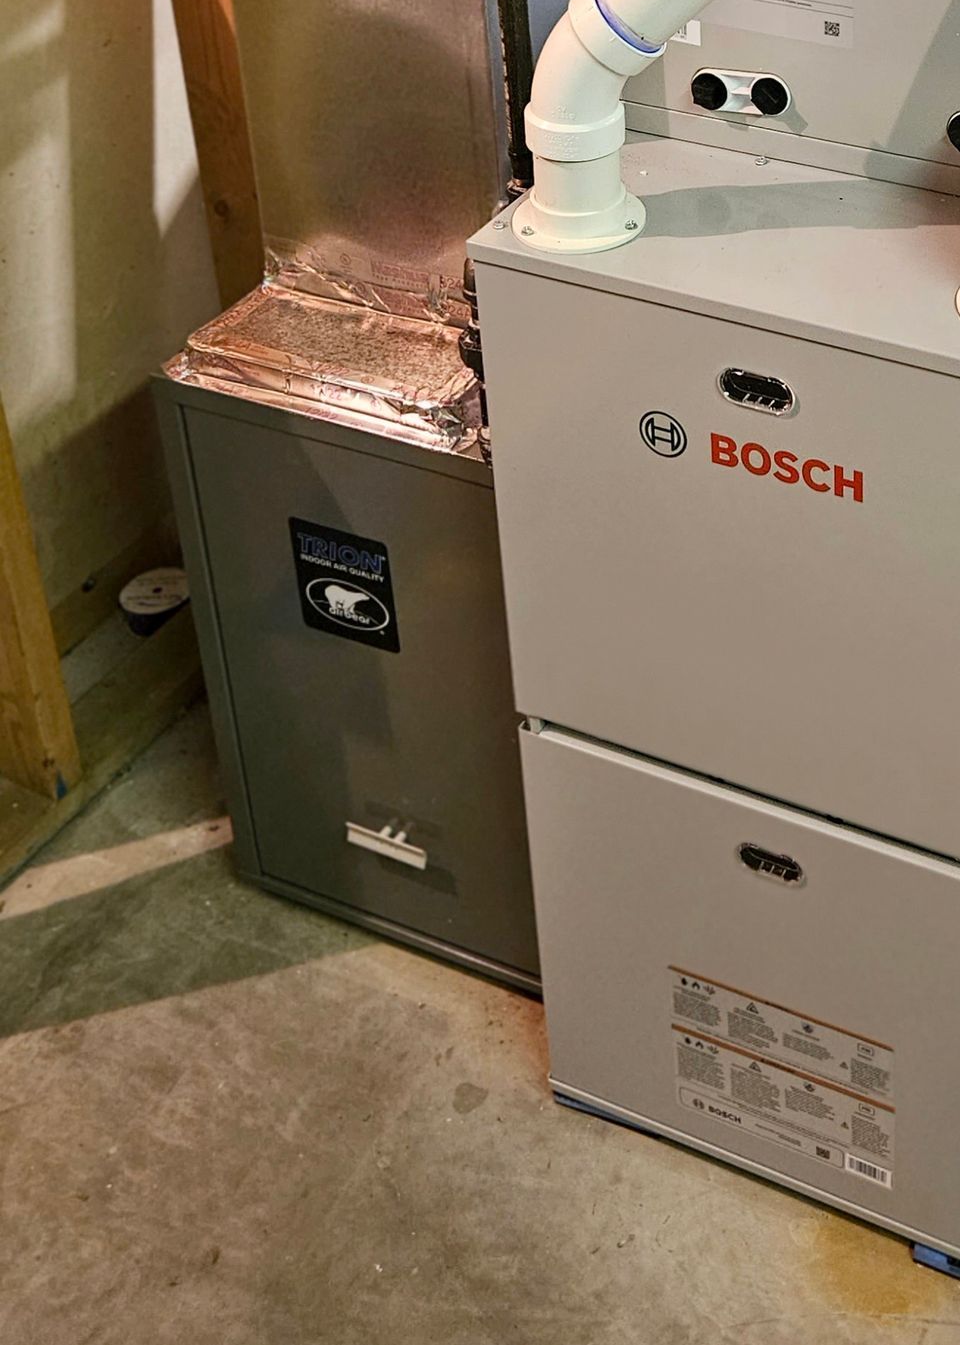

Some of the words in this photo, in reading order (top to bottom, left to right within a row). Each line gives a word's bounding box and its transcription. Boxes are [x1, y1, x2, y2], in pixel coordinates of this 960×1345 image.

[711, 432, 863, 503] BOSCH
[297, 532, 383, 574] TRION
[301, 553, 331, 568] INDOOR
[333, 562, 347, 572] AIR
[349, 567, 384, 583] QUALITY
